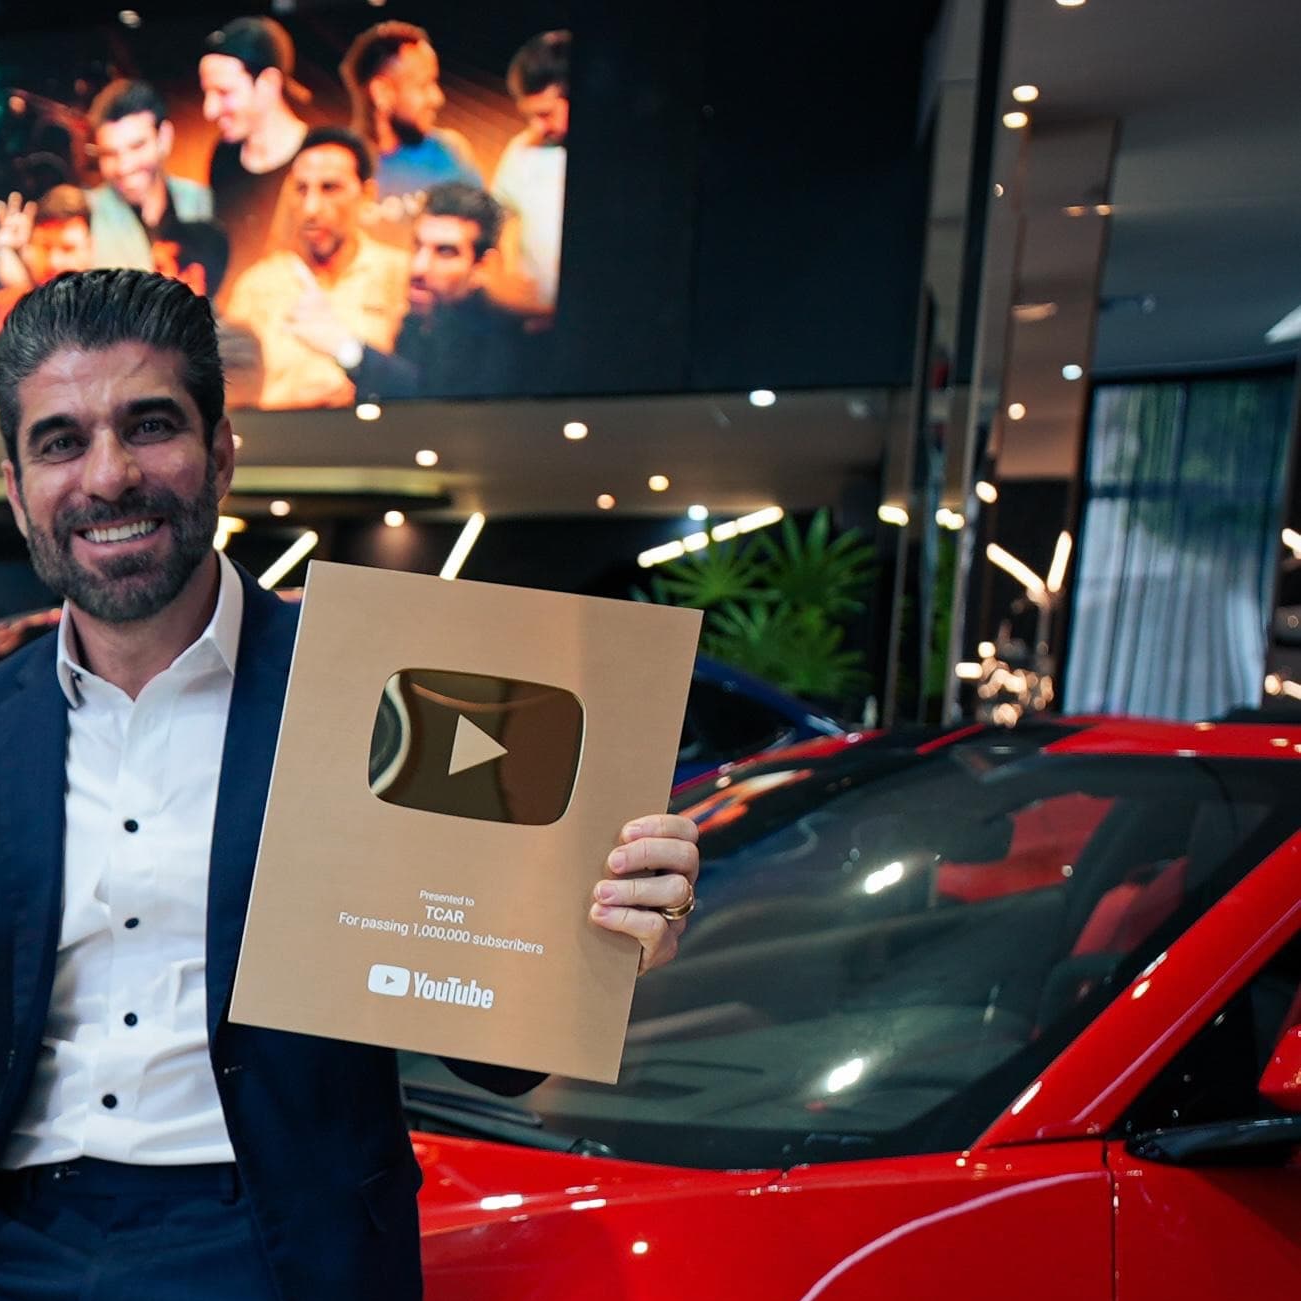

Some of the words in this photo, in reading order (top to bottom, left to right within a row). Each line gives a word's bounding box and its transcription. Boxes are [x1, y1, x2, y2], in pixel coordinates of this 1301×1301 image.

[419, 889, 464, 906] Presented
[465, 896, 475, 907] to
[425, 905, 464, 924] TCAR
[338, 911, 362, 927] For
[361, 916, 409, 937] passing
[412, 922, 471, 944] 1,000,000
[472, 934, 544, 955] subscribers
[413, 971, 495, 1009] YouTube
